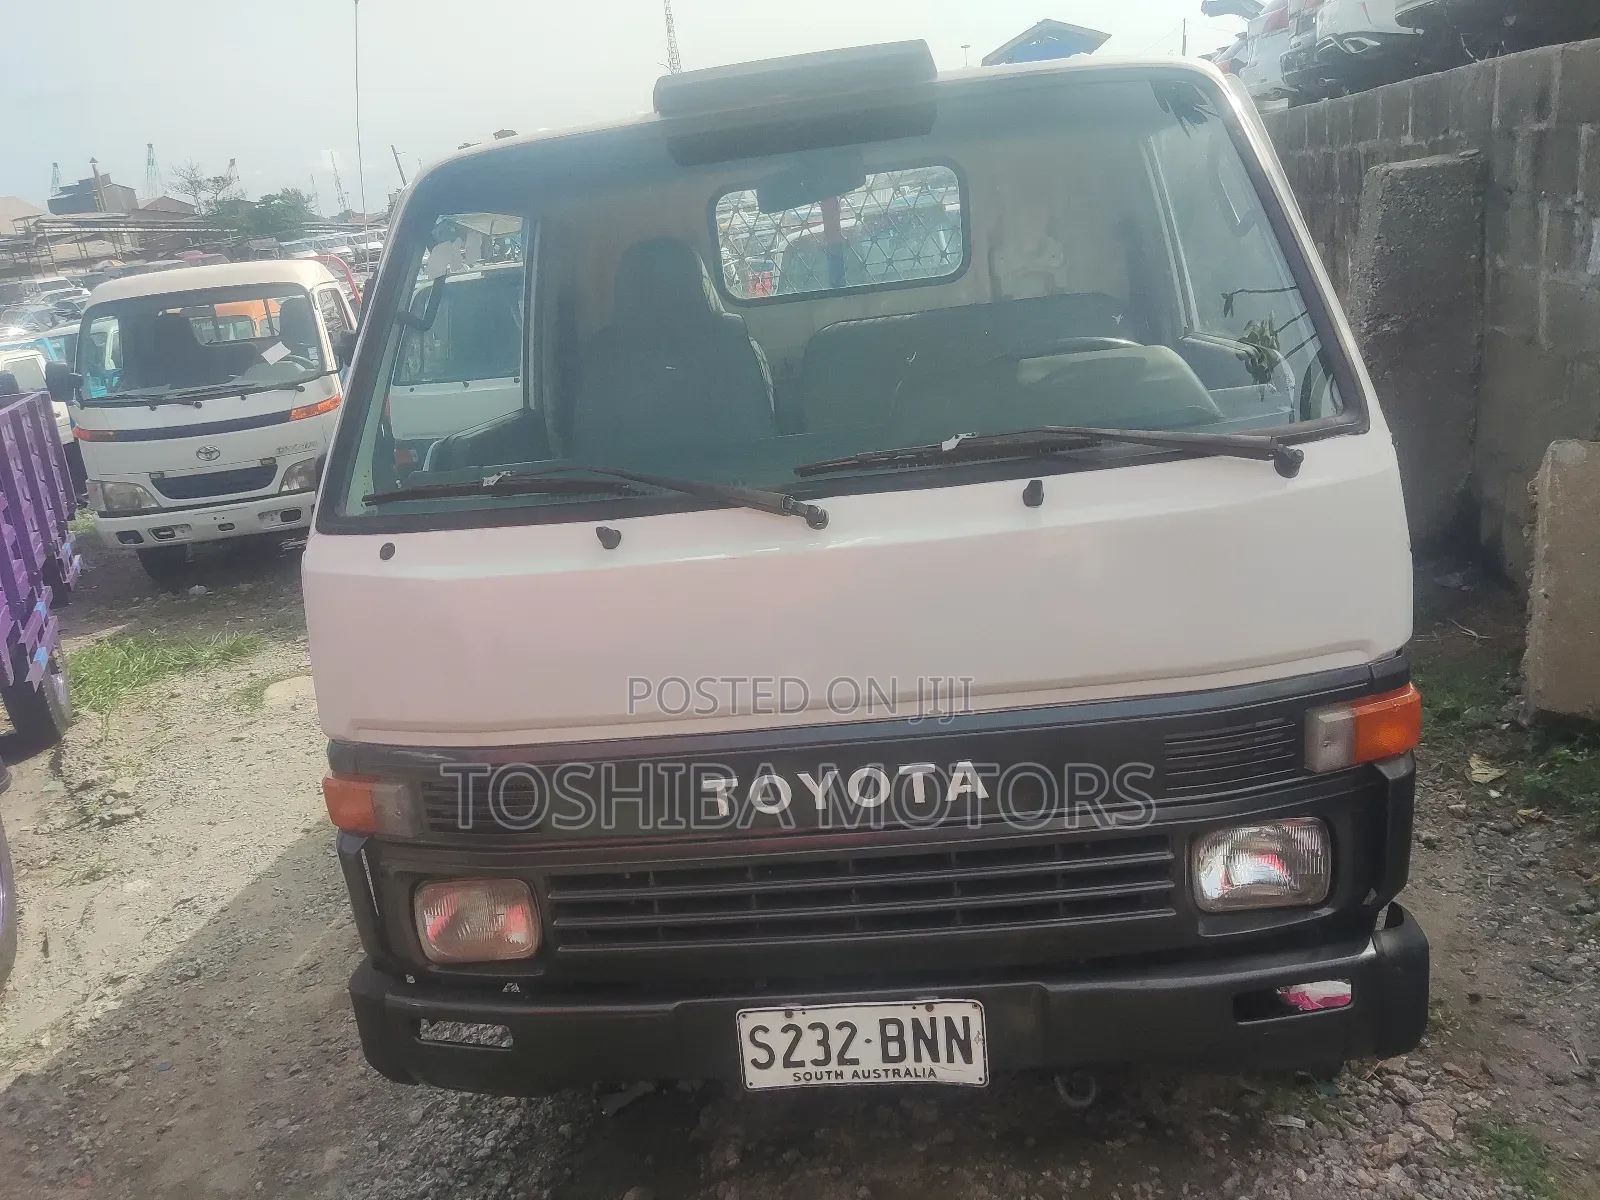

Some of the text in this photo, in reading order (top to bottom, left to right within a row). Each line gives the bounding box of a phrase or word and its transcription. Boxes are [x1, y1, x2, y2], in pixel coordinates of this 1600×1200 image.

[701, 760, 989, 816] TOYOTA
[793, 1066, 937, 1082] SOUTH AUSTRALIA
